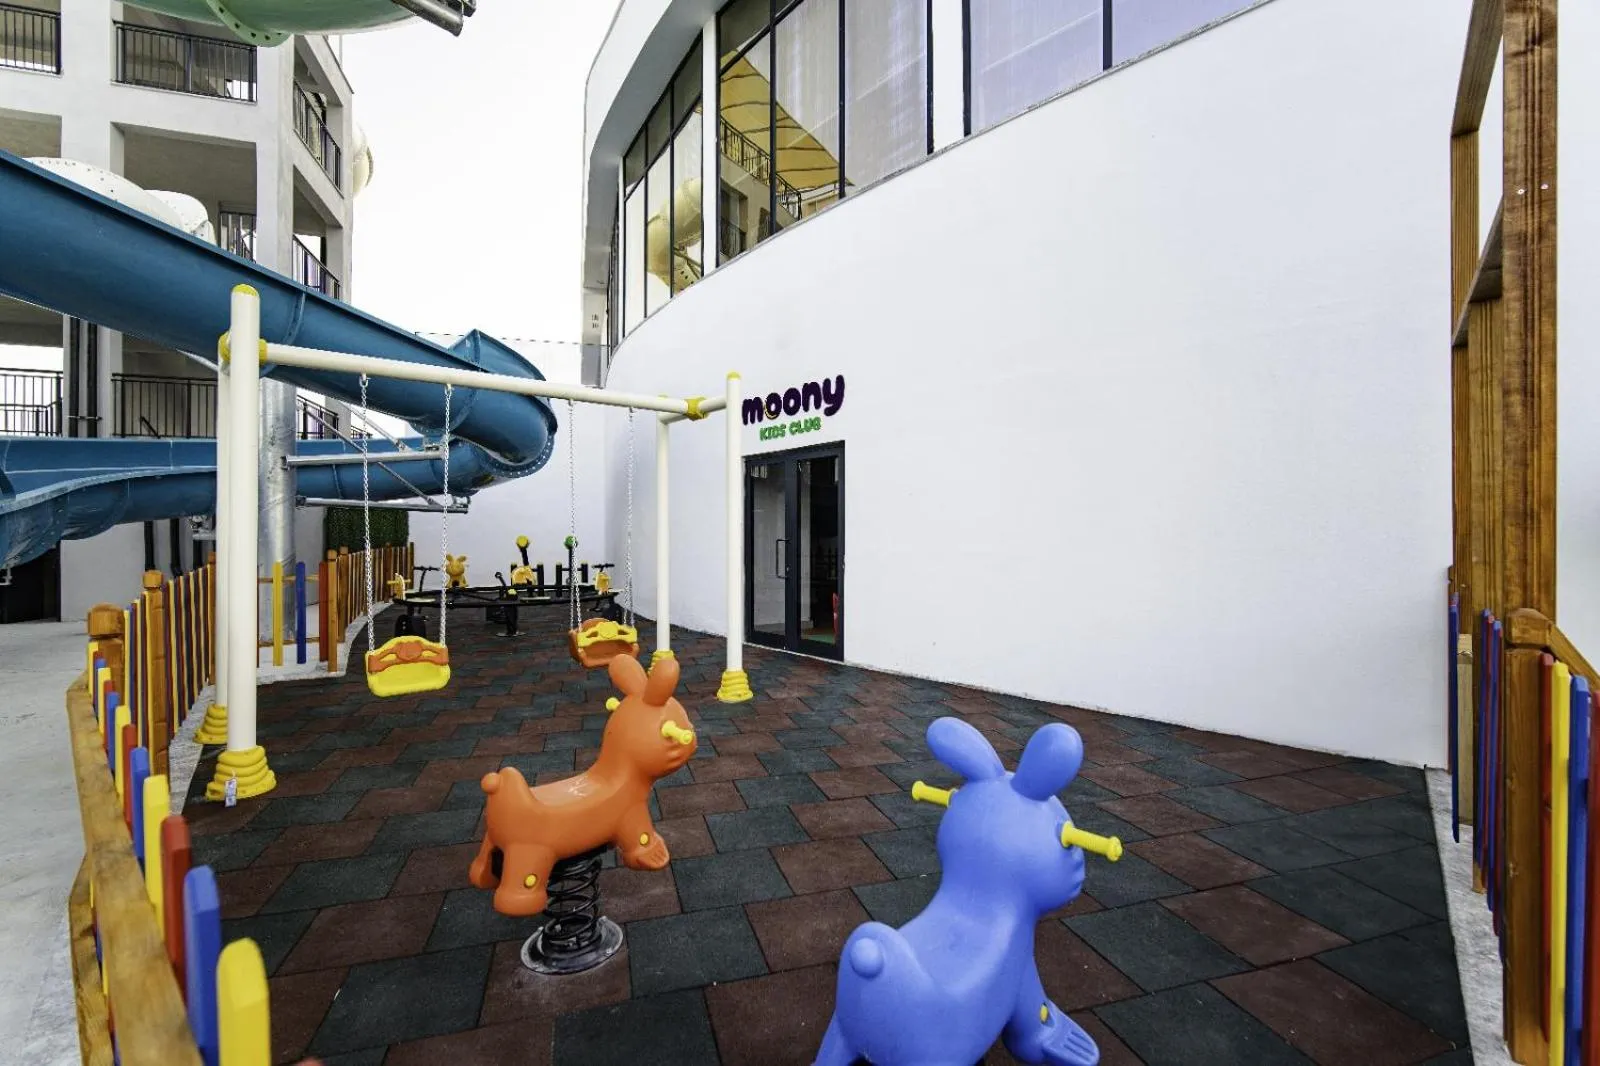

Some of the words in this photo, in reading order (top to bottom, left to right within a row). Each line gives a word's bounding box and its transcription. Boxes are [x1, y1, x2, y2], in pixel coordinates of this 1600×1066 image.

[742, 374, 845, 425] moony
[759, 424, 786, 441] KIDS
[789, 416, 821, 435] CLUB
